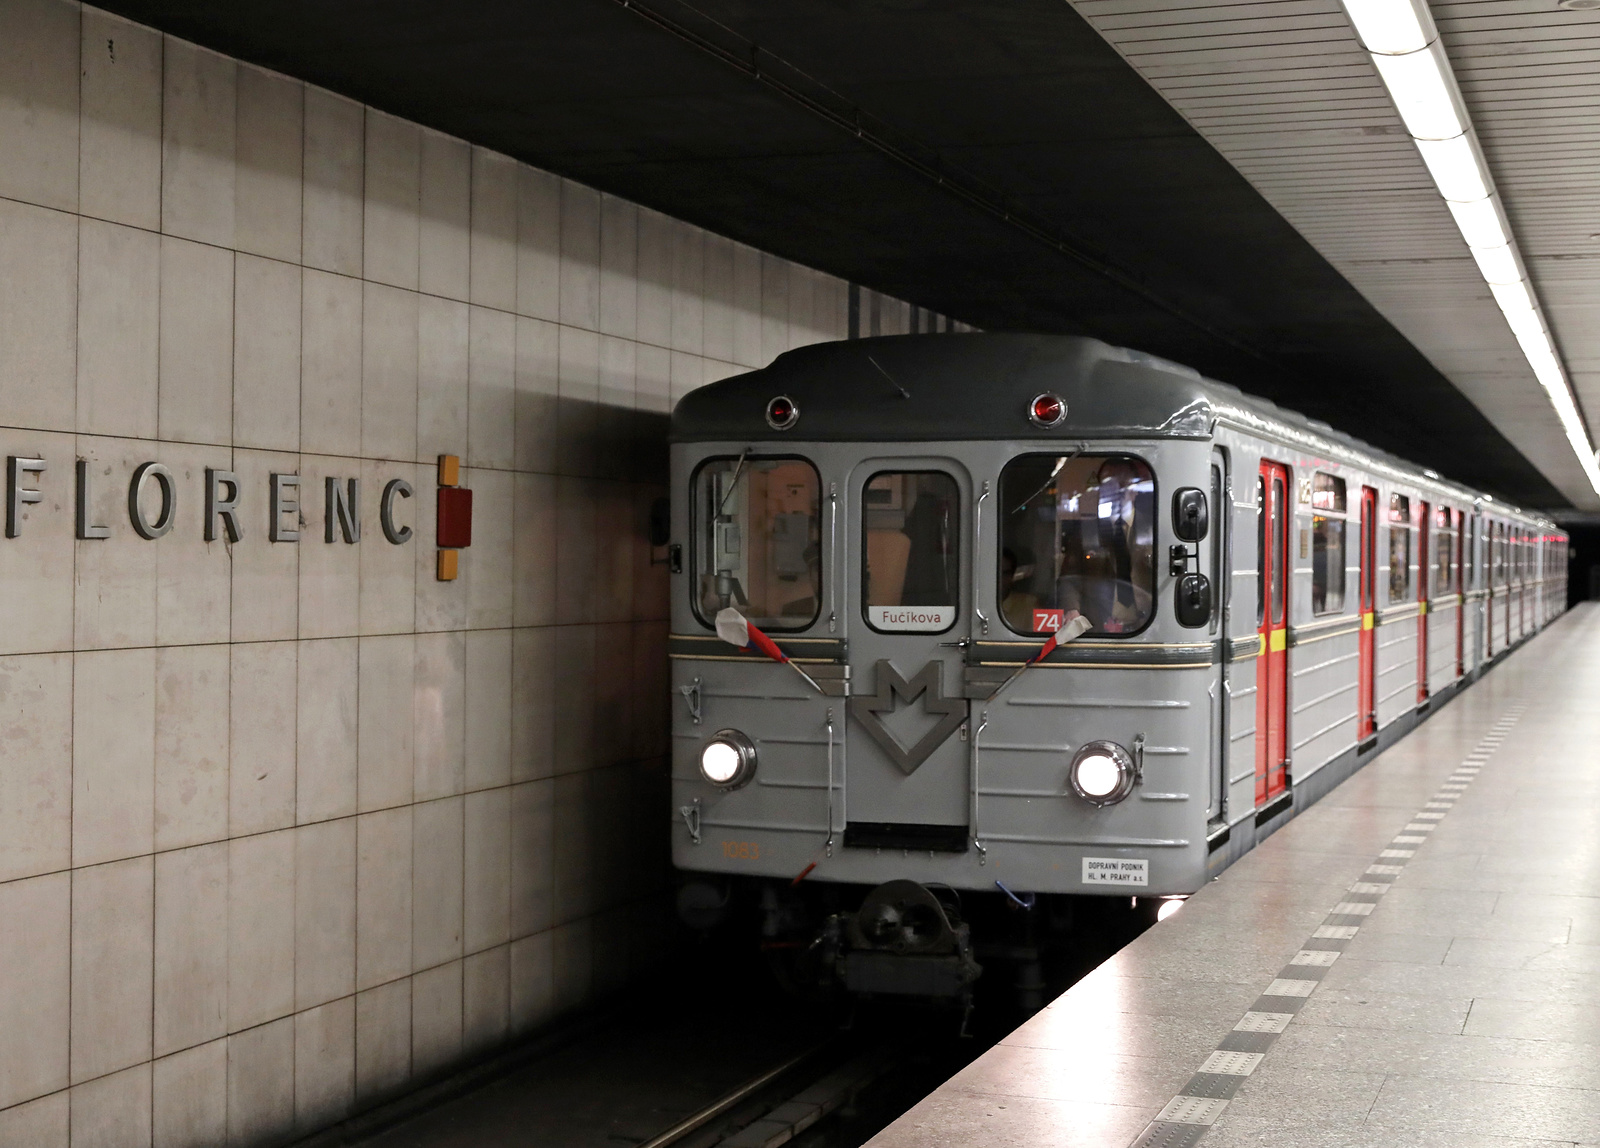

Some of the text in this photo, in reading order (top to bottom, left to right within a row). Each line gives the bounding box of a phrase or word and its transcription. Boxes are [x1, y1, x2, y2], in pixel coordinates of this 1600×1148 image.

[6, 456, 414, 545] FLORENC
[882, 611, 941, 623] Fučíkova
[1036, 613, 1060, 632] 74
[722, 841, 760, 860] 1083
[1088, 861, 1144, 871] DOPRAVNÍ PODNIK
[1110, 873, 1131, 881] PRAHY
